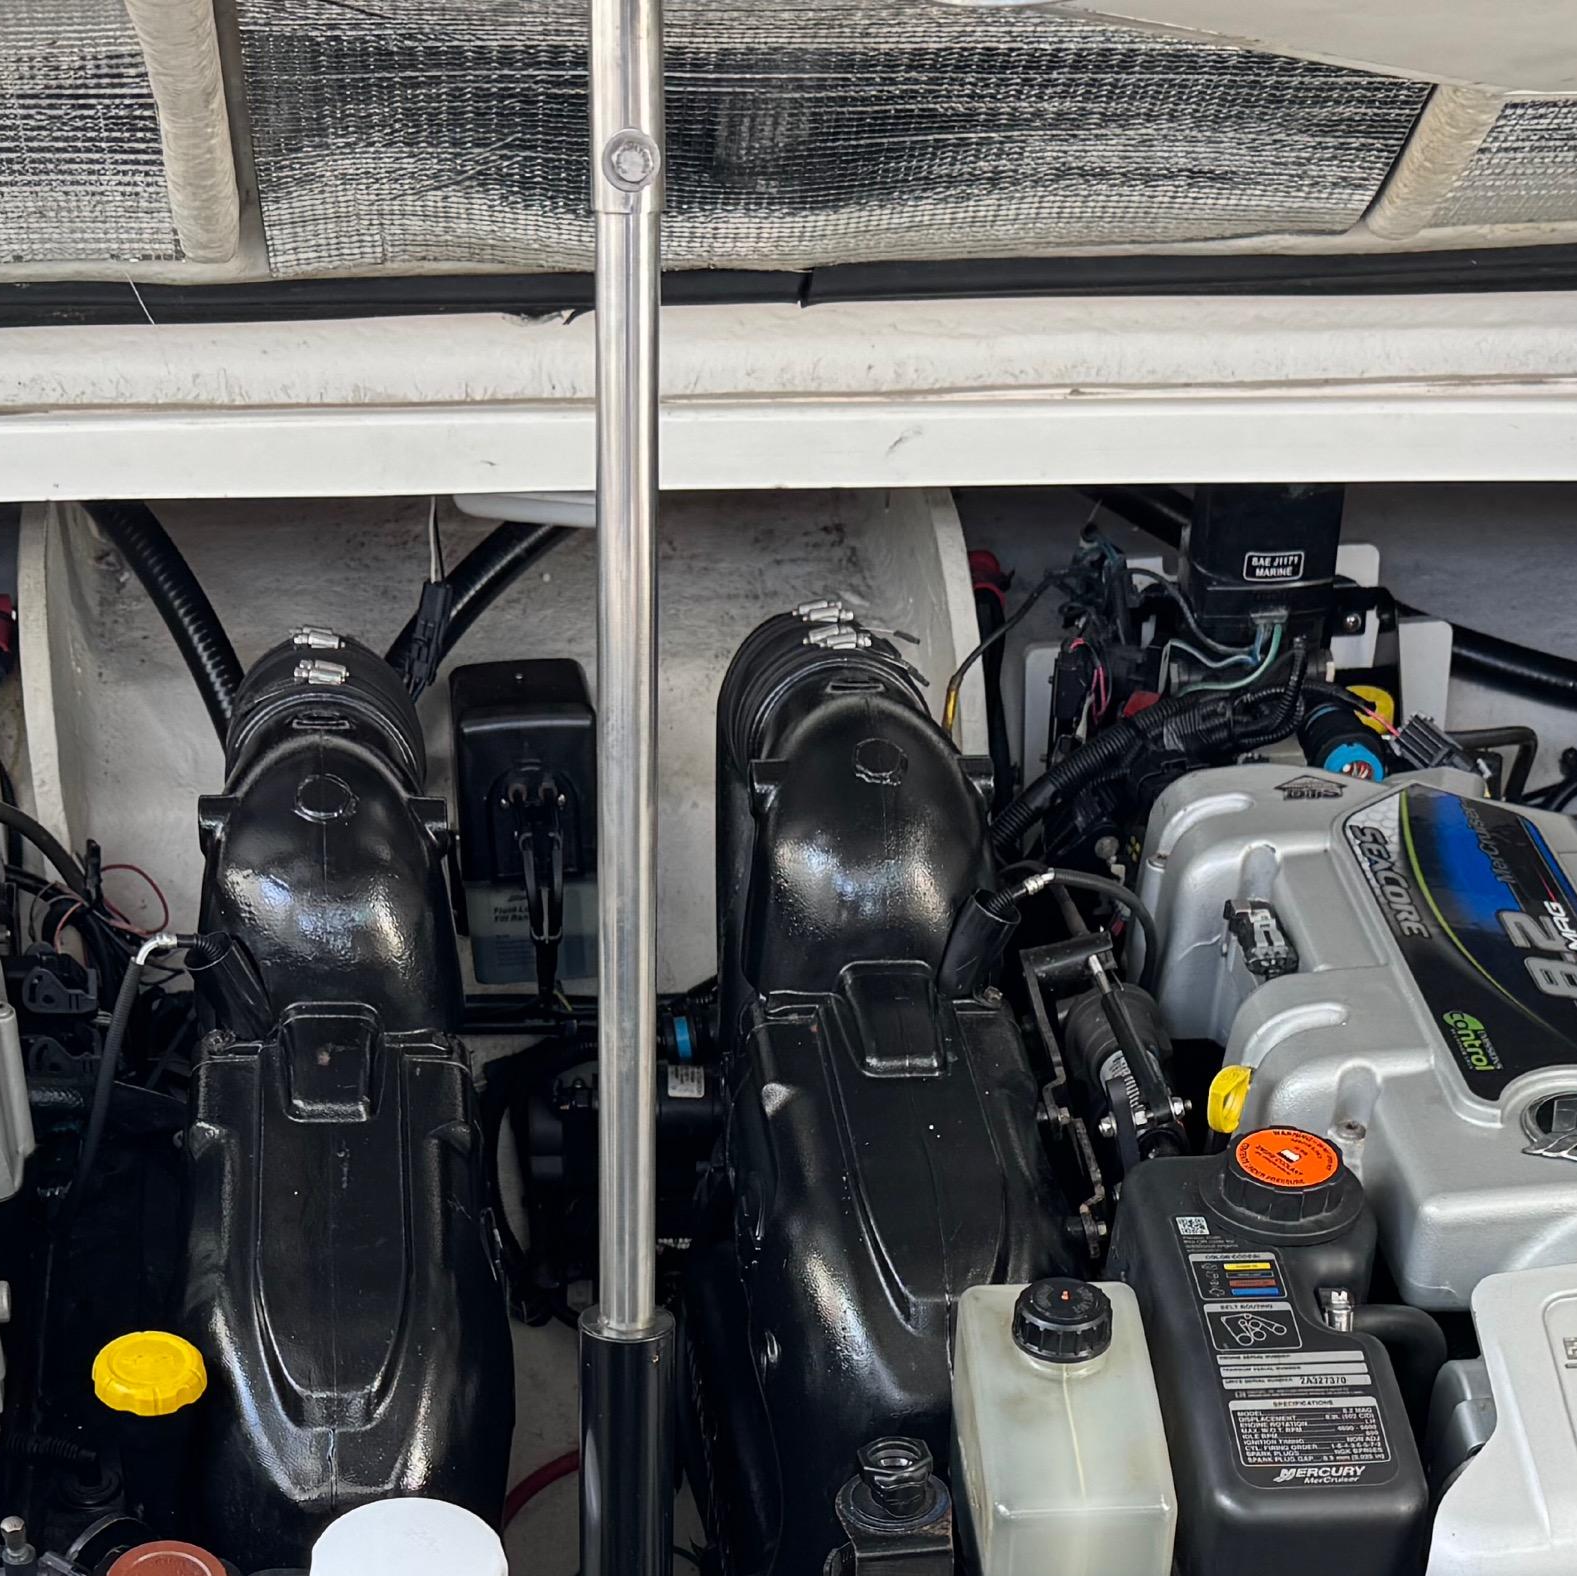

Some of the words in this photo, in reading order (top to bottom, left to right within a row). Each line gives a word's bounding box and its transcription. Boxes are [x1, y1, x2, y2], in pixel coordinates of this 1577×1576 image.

[1252, 557, 1271, 566] SAE
[1256, 567, 1293, 576] MARINE
[1348, 824, 1432, 940] SEACORE
[1450, 1012, 1494, 1070] control
[1277, 1466, 1366, 1479] MERCURY
[1304, 1476, 1360, 1484] MerCruiser
